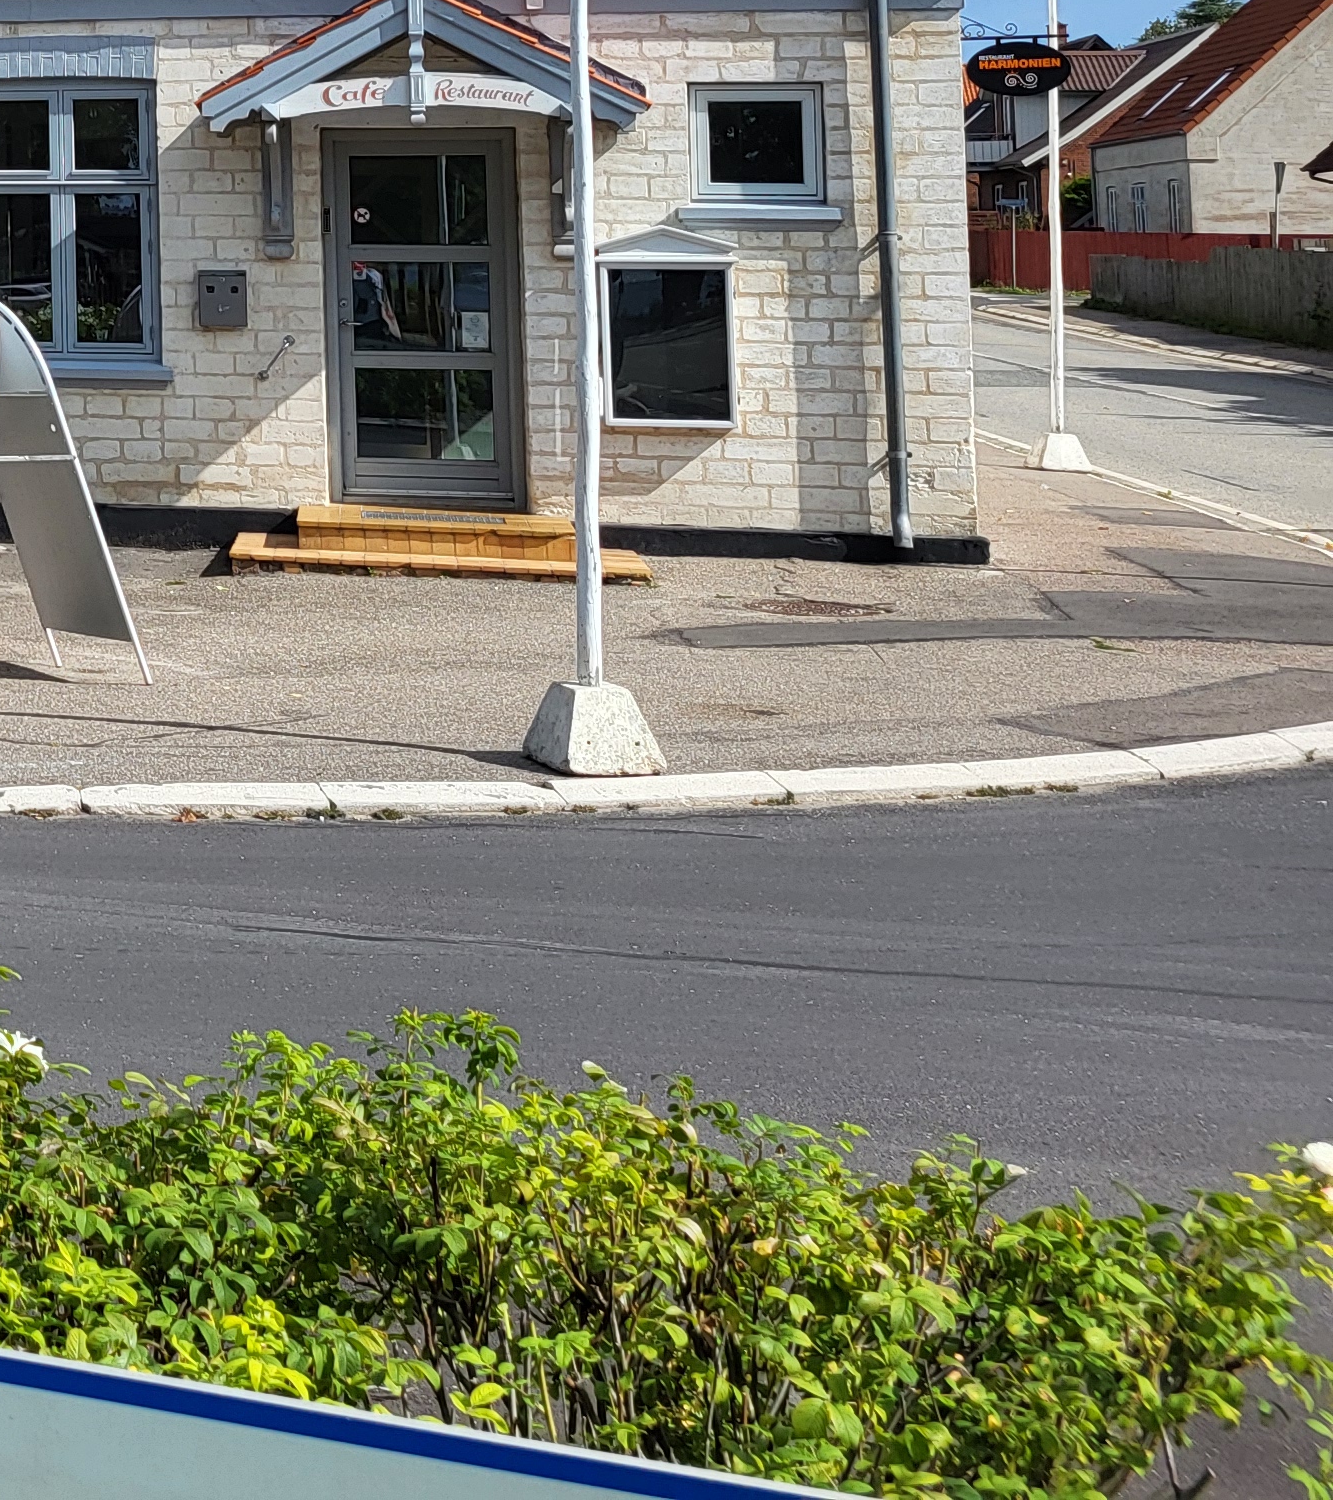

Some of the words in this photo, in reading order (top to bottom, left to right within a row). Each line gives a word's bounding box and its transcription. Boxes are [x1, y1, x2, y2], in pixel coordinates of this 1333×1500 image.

[979, 58, 1061, 70] HARMONIEN
[322, 80, 387, 107] Café
[434, 78, 535, 108] Restaurant
